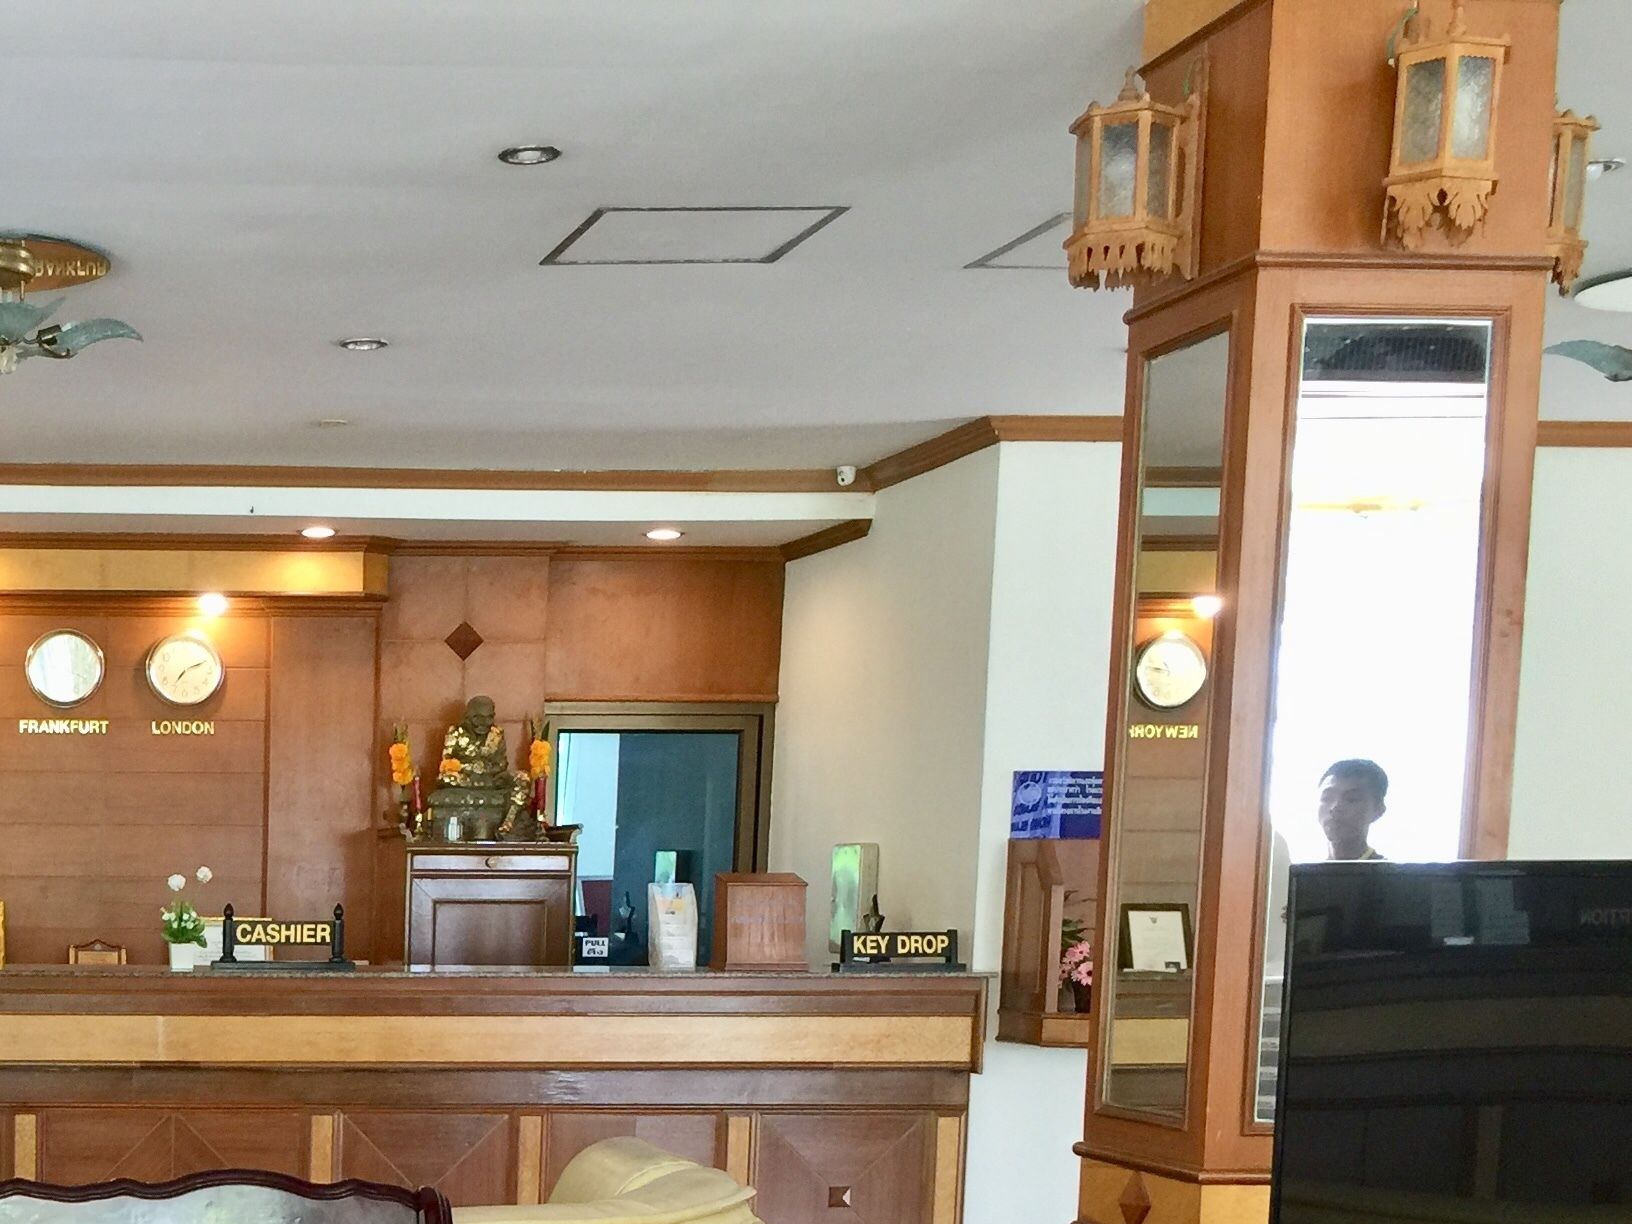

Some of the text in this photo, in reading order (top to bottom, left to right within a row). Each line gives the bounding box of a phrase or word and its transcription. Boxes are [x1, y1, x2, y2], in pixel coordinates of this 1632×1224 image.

[19, 719, 109, 735] FRANKFURT
[151, 720, 215, 735] LONDON
[236, 923, 331, 943] CASHIER
[853, 935, 949, 954] KEY DROP
